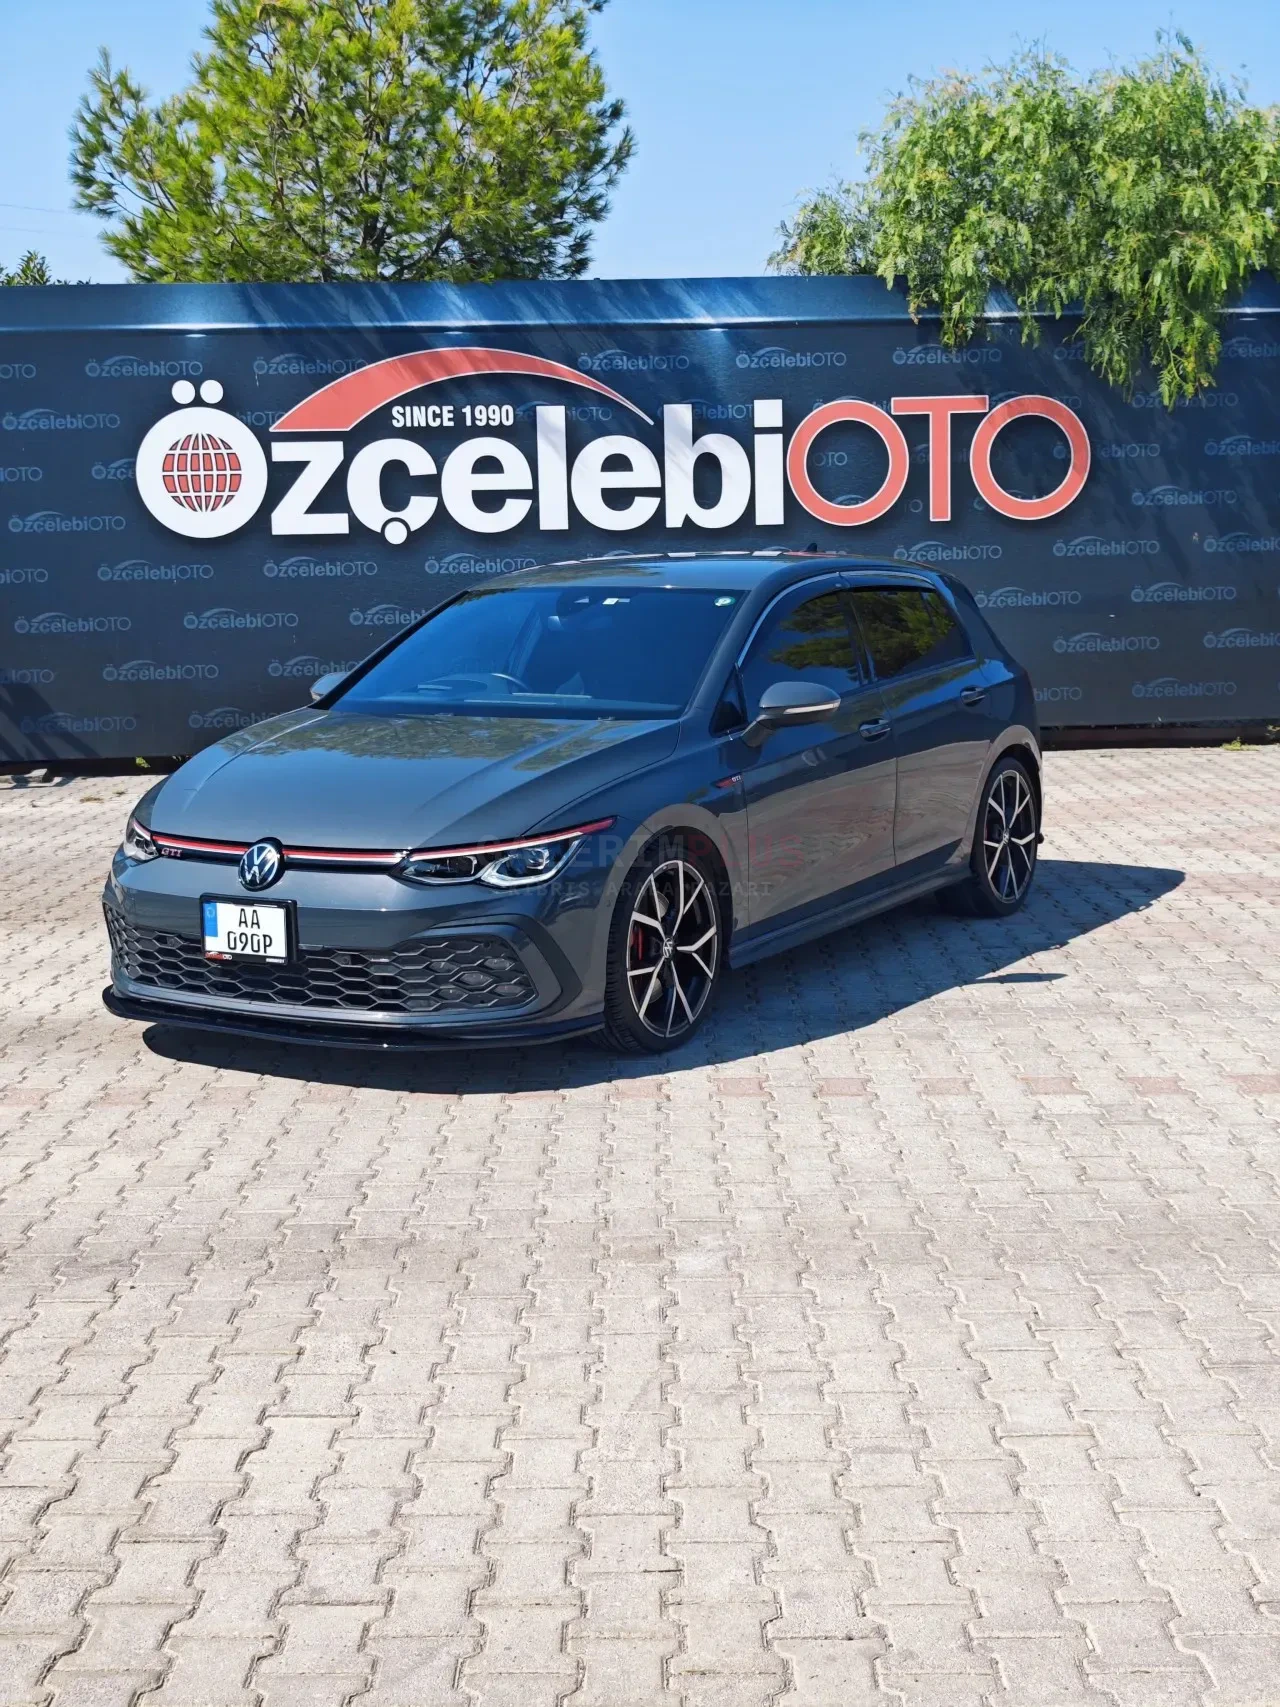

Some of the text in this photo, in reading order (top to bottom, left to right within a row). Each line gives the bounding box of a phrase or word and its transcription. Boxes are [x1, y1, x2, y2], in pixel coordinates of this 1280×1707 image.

[391, 404, 514, 427] SINCE 1990
[161, 847, 183, 858] GTI
[238, 907, 261, 930] AA
